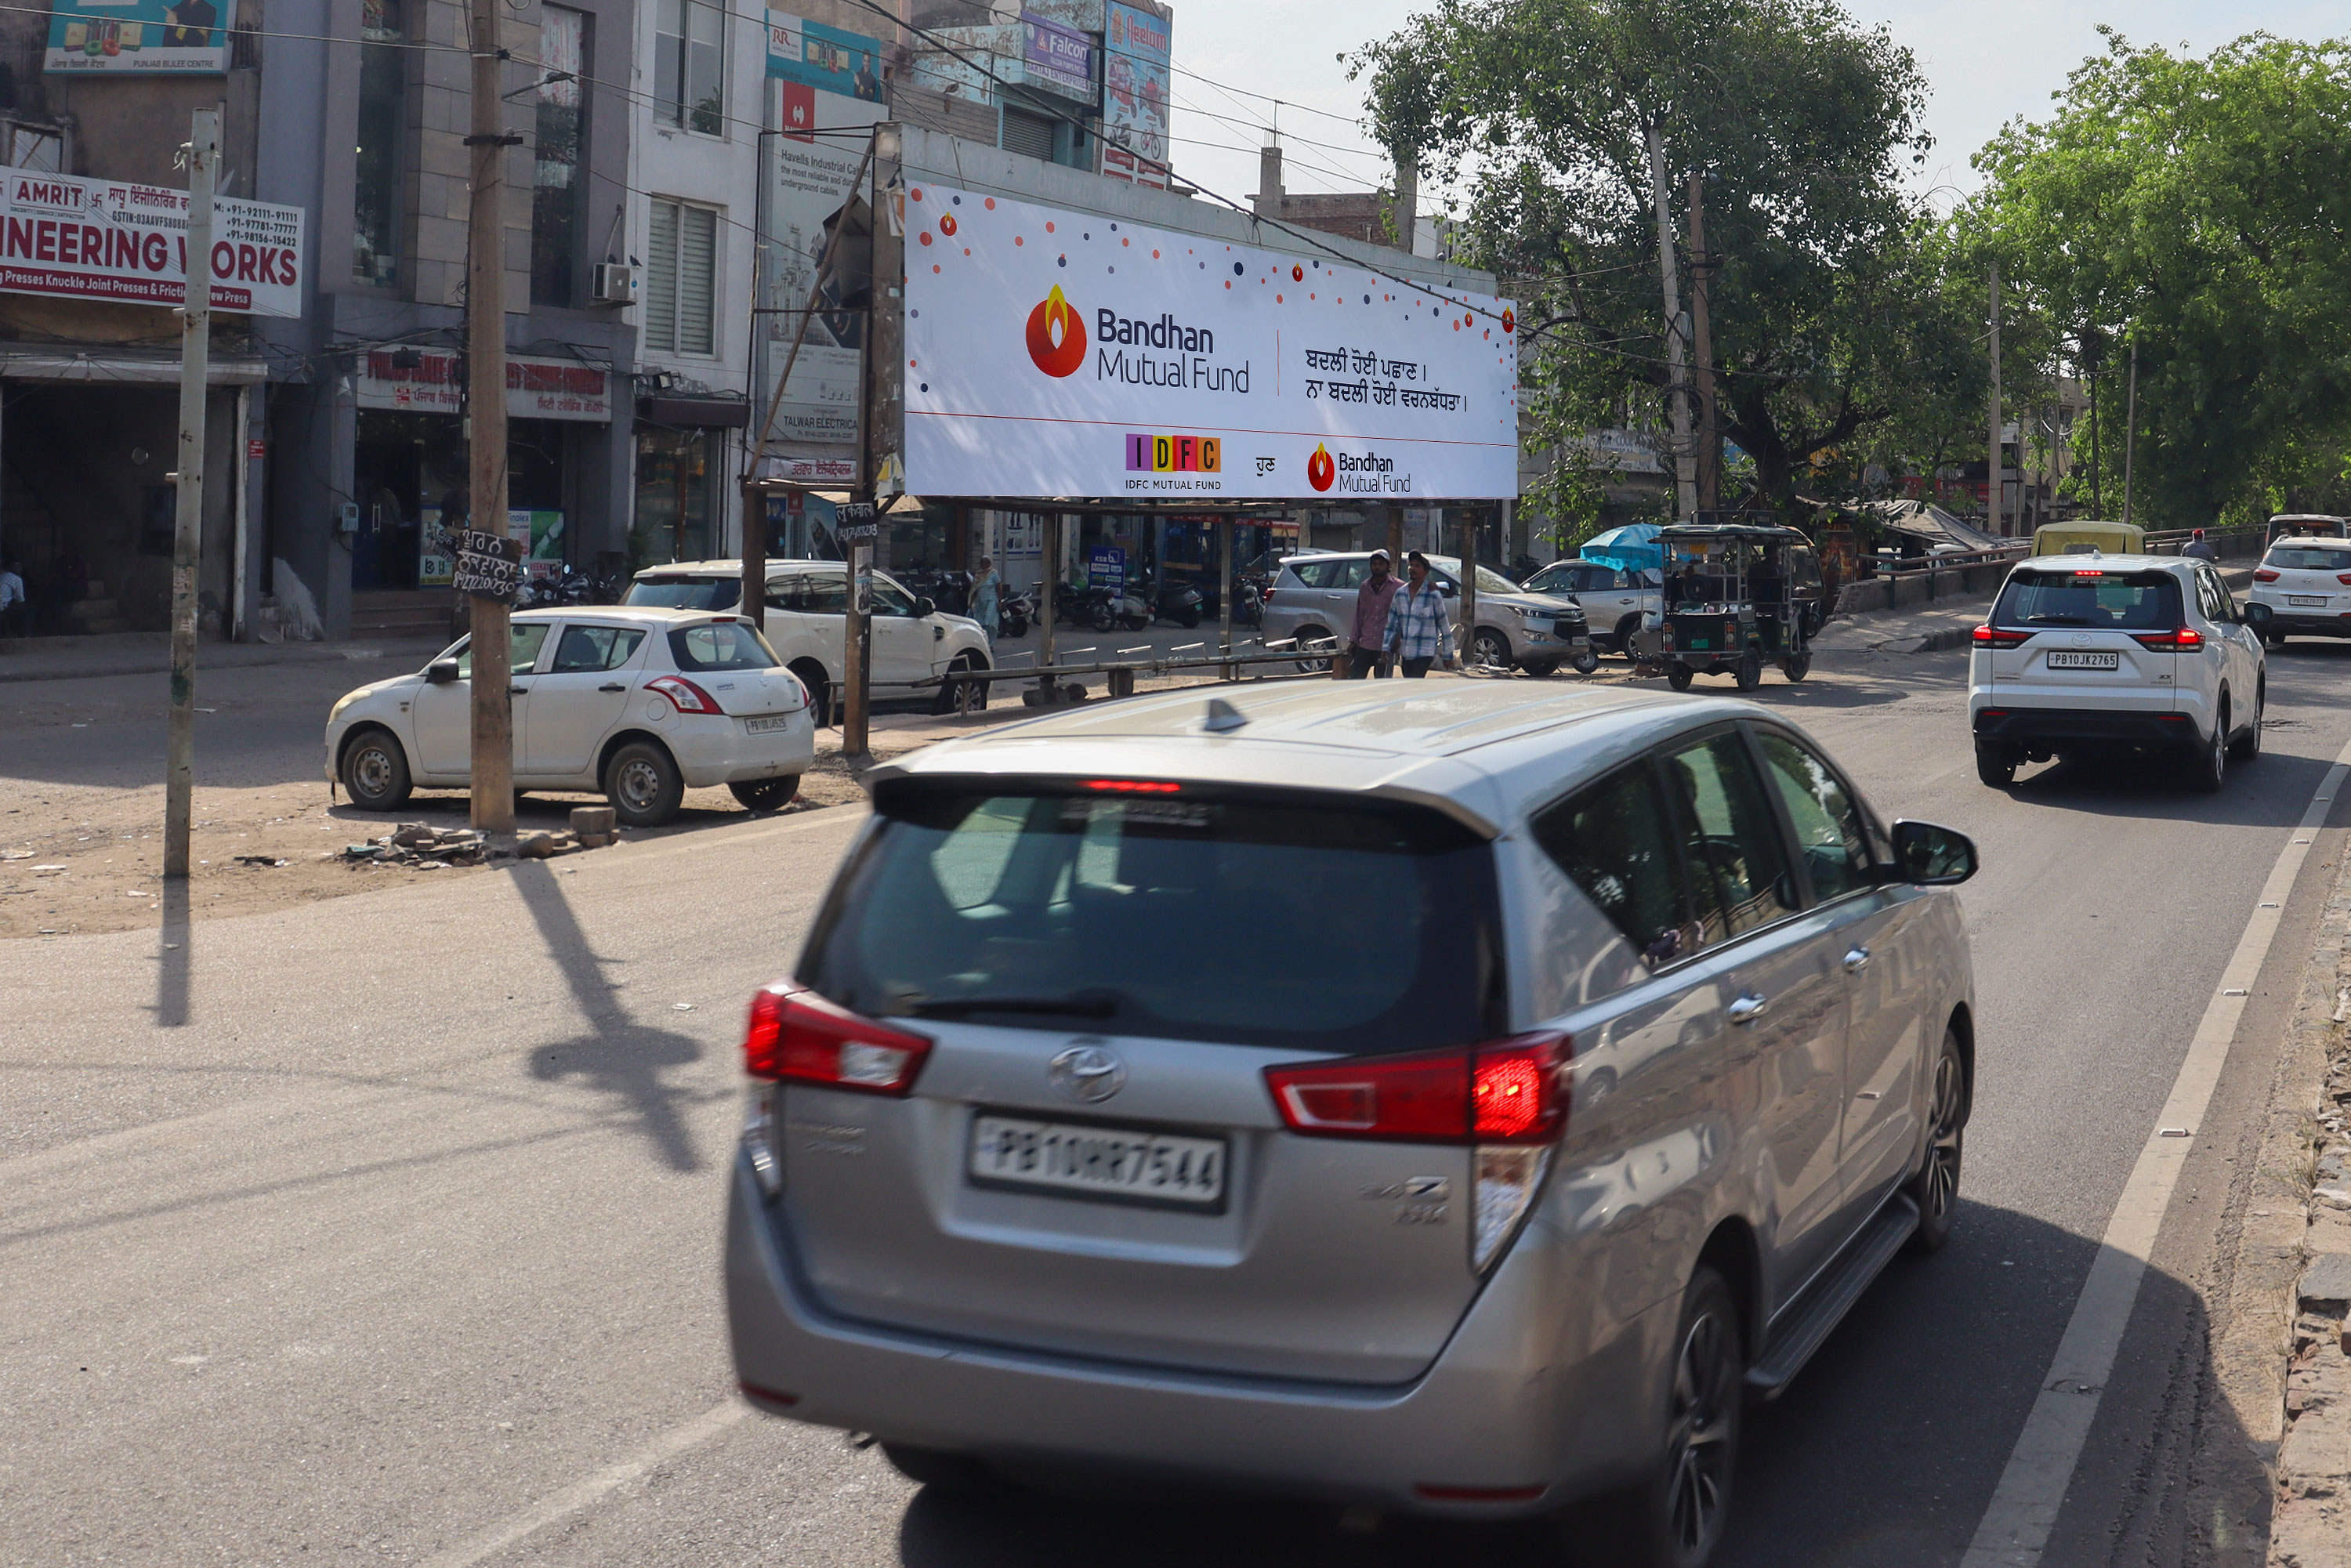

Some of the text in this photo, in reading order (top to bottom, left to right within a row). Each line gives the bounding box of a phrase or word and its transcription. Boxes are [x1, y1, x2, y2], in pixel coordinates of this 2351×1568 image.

[1049, 34, 1088, 60] Falcon
[132, 60, 215, 68] PUNJAB BIJLEE CENTRE
[781, 149, 810, 166] Havells
[810, 155, 846, 172] Industrial
[792, 166, 807, 178] most
[808, 170, 829, 183] reliable
[830, 175, 842, 185] and
[16, 180, 83, 207] AMRIT
[108, 186, 127, 208] ਸਾਧੂ
[781, 178, 840, 197] underground cables.
[226, 205, 298, 223] +91-92111-91111
[226, 217, 298, 235] +91-97781-77777
[226, 230, 296, 247] +91-98156-15422
[5, 271, 44, 286] Presses
[45, 274, 85, 289] Knuckle
[87, 277, 111, 292] Joint
[112, 280, 148, 295] Presses
[150, 283, 158, 295] &
[224, 291, 248, 305] Press
[1097, 307, 1214, 354] Bandhan
[1098, 347, 1249, 393] Mutual Fund
[1305, 346, 1348, 373] ਬਦਲੀ
[1351, 347, 1378, 377] ਹੋਈ
[1380, 359, 1418, 381] ਪਛਾਣ
[1305, 378, 1324, 400] ਨਾ
[1328, 378, 1369, 404] ਬਦਲੀ
[1371, 378, 1397, 407] ਹੋਈ
[784, 415, 815, 429] TALWAR
[1136, 436, 1215, 470] IDFC
[1339, 451, 1393, 473] Bandhan
[1255, 456, 1276, 476] ਹੁਣ
[1125, 480, 1222, 491] IDFC MUTUAL FUND
[1339, 473, 1411, 493] Mutual Fund
[508, 512, 530, 523] inolex
[2055, 654, 2116, 666] PB10JK2765
